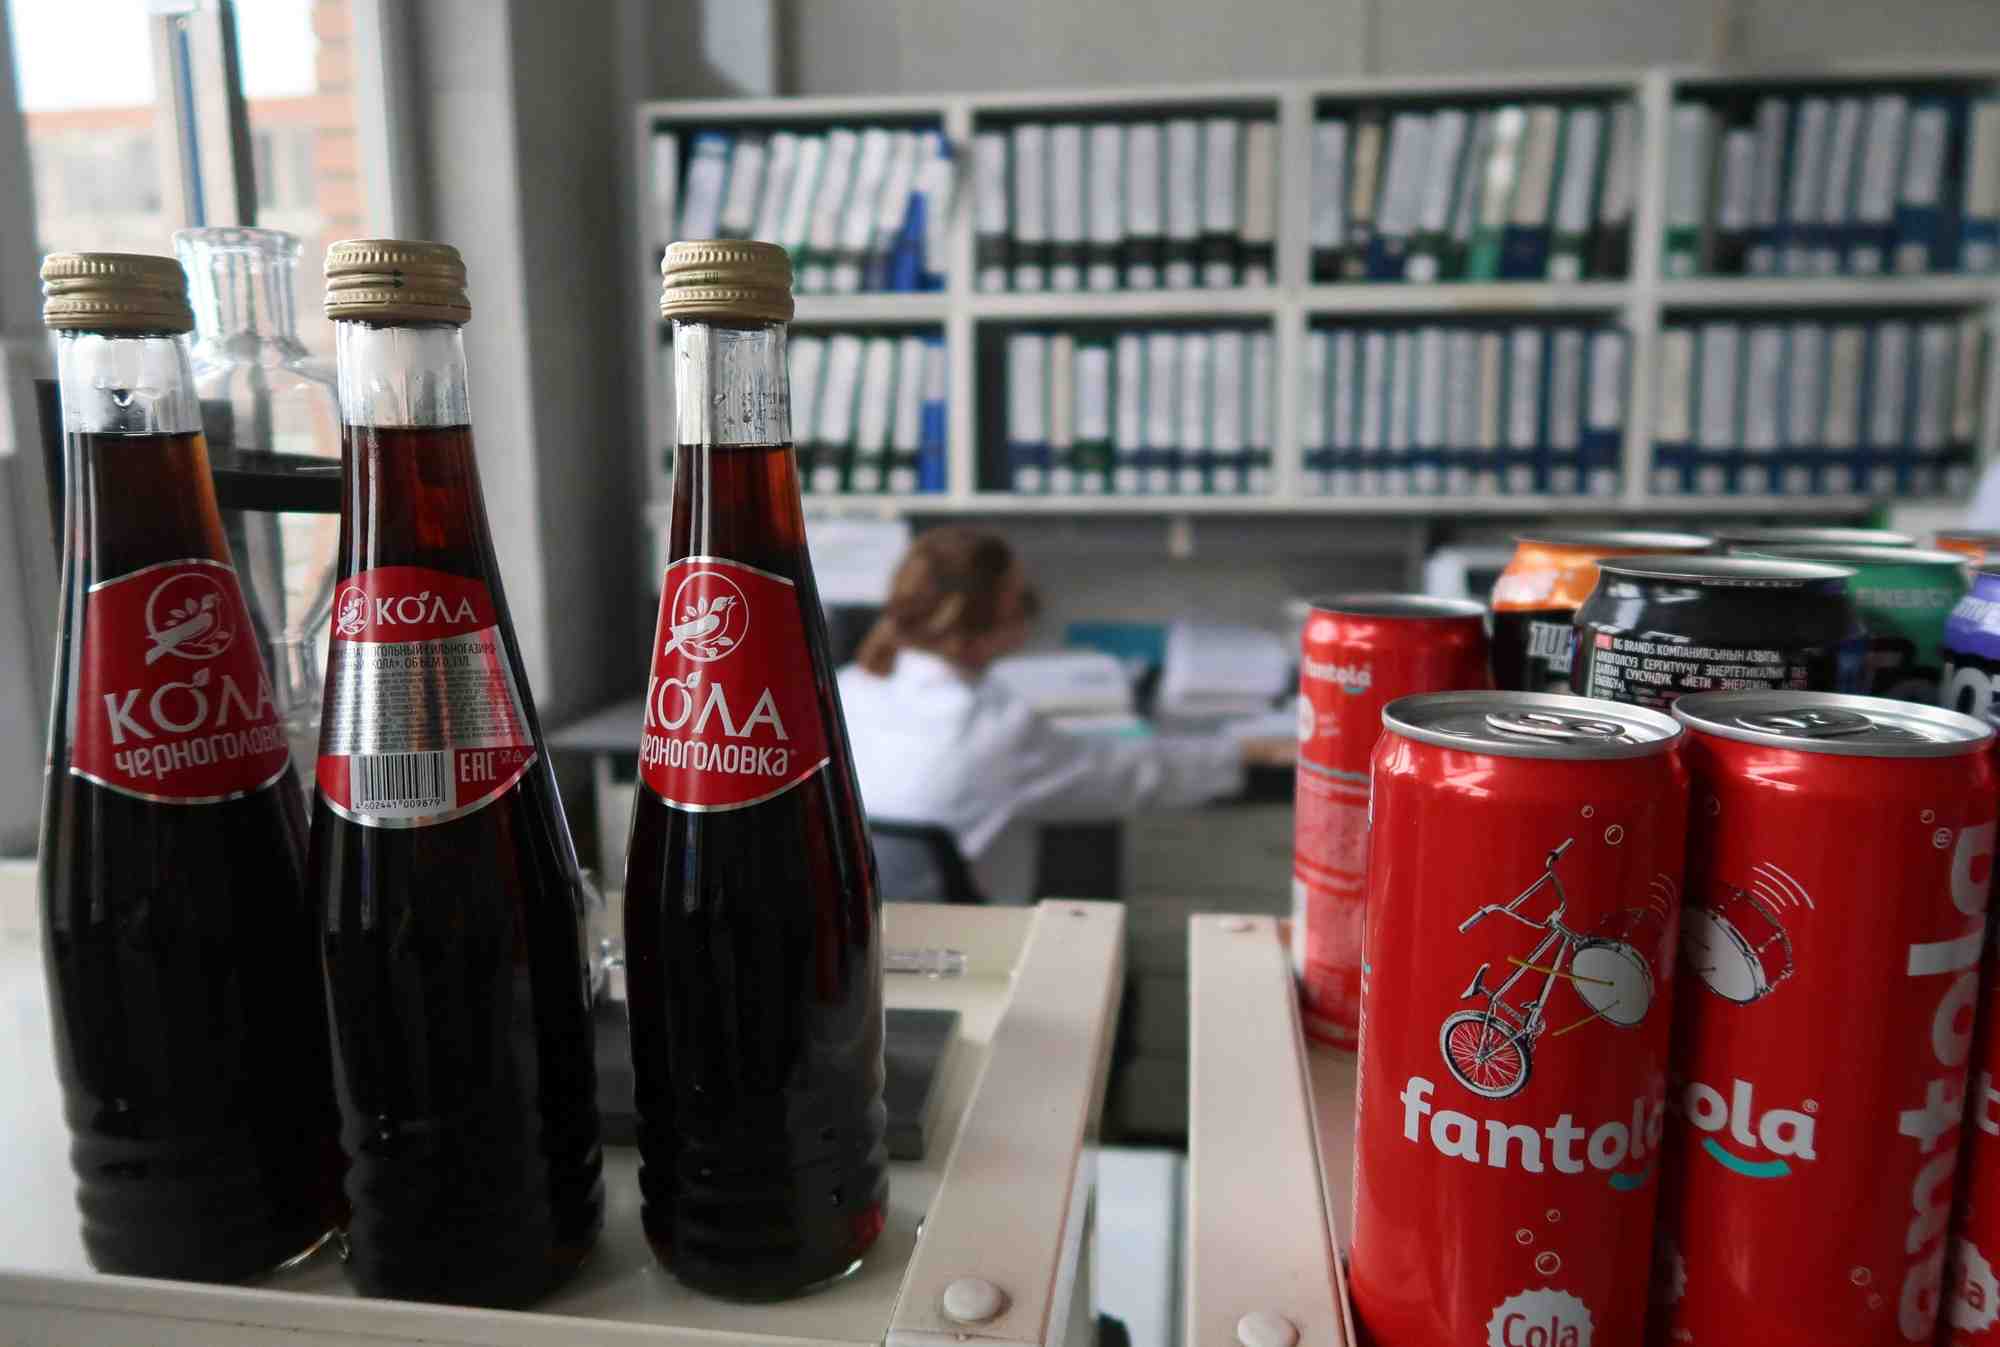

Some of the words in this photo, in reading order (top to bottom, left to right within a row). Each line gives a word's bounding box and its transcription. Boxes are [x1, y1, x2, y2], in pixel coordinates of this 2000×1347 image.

[376, 591, 479, 625] КОЛА
[1624, 640, 1656, 655] BRANDS
[104, 667, 288, 745] КОЛА
[1503, 1313, 1579, 1347] Cola
